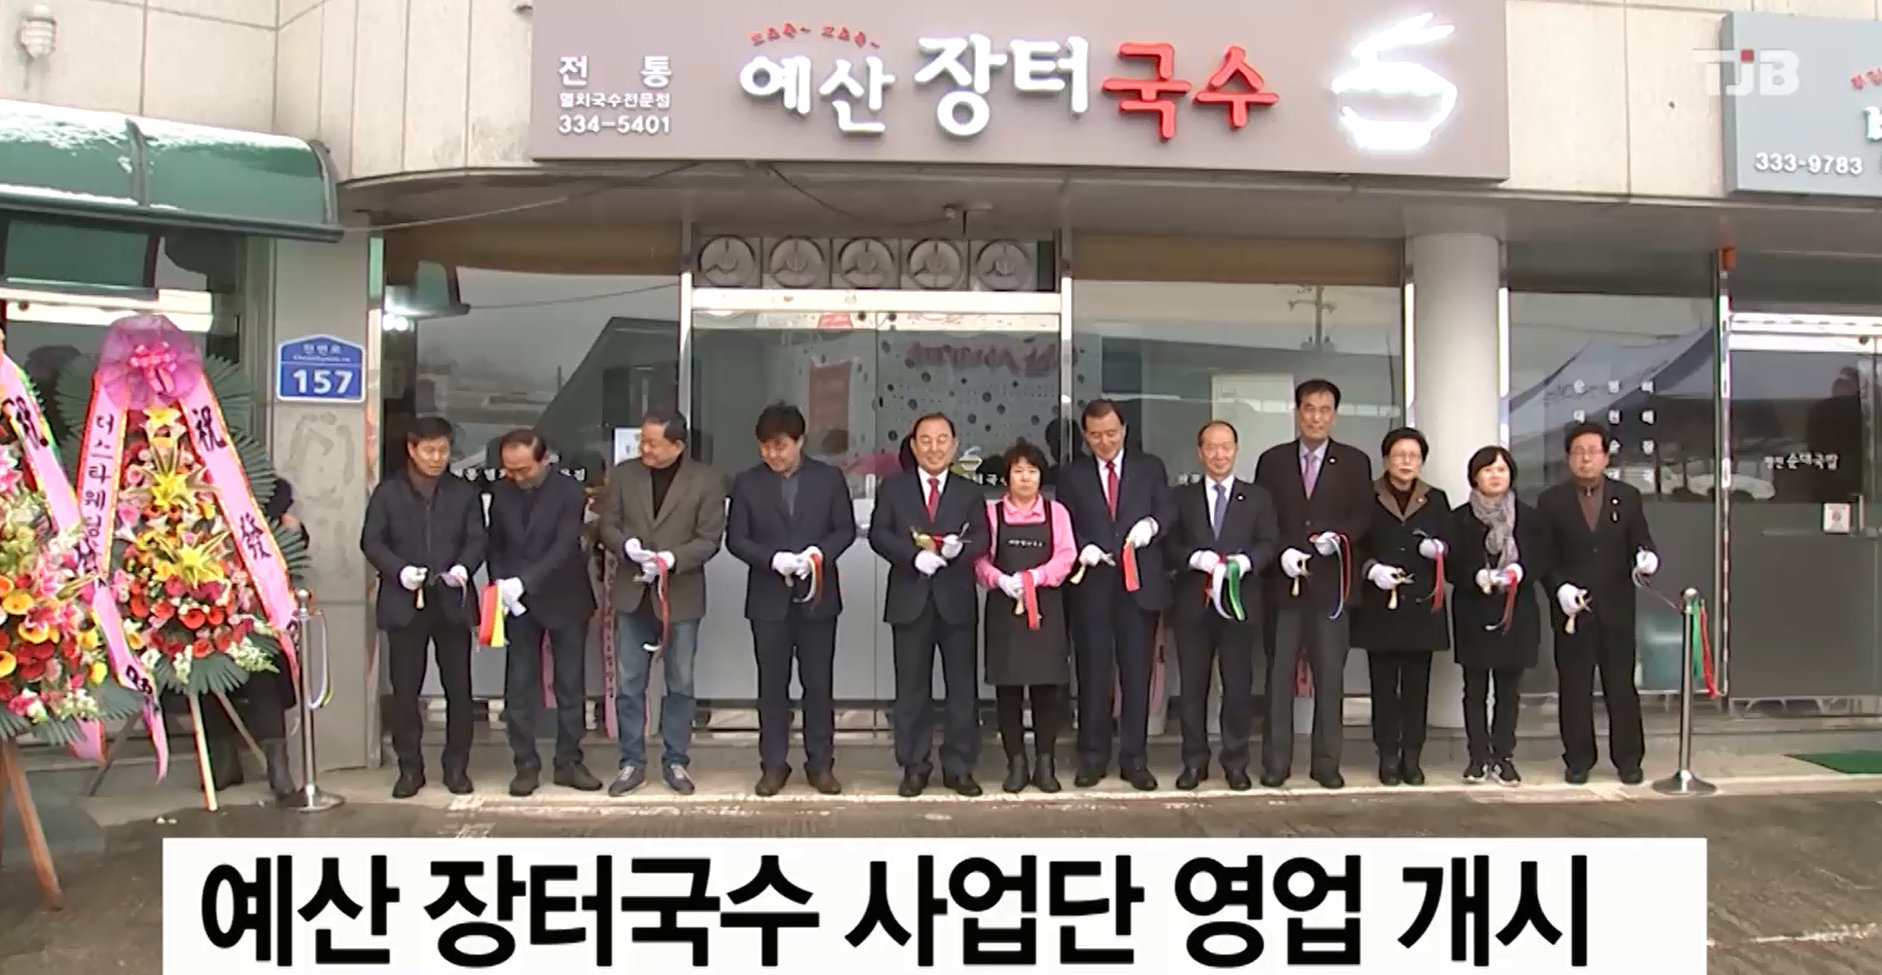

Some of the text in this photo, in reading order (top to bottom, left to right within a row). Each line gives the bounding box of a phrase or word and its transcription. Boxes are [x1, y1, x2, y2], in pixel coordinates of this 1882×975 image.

[739, 55, 897, 133] 예산
[559, 114, 671, 135] 334-5401
[1755, 151, 1864, 176] 333-9783
[293, 369, 353, 395] 157
